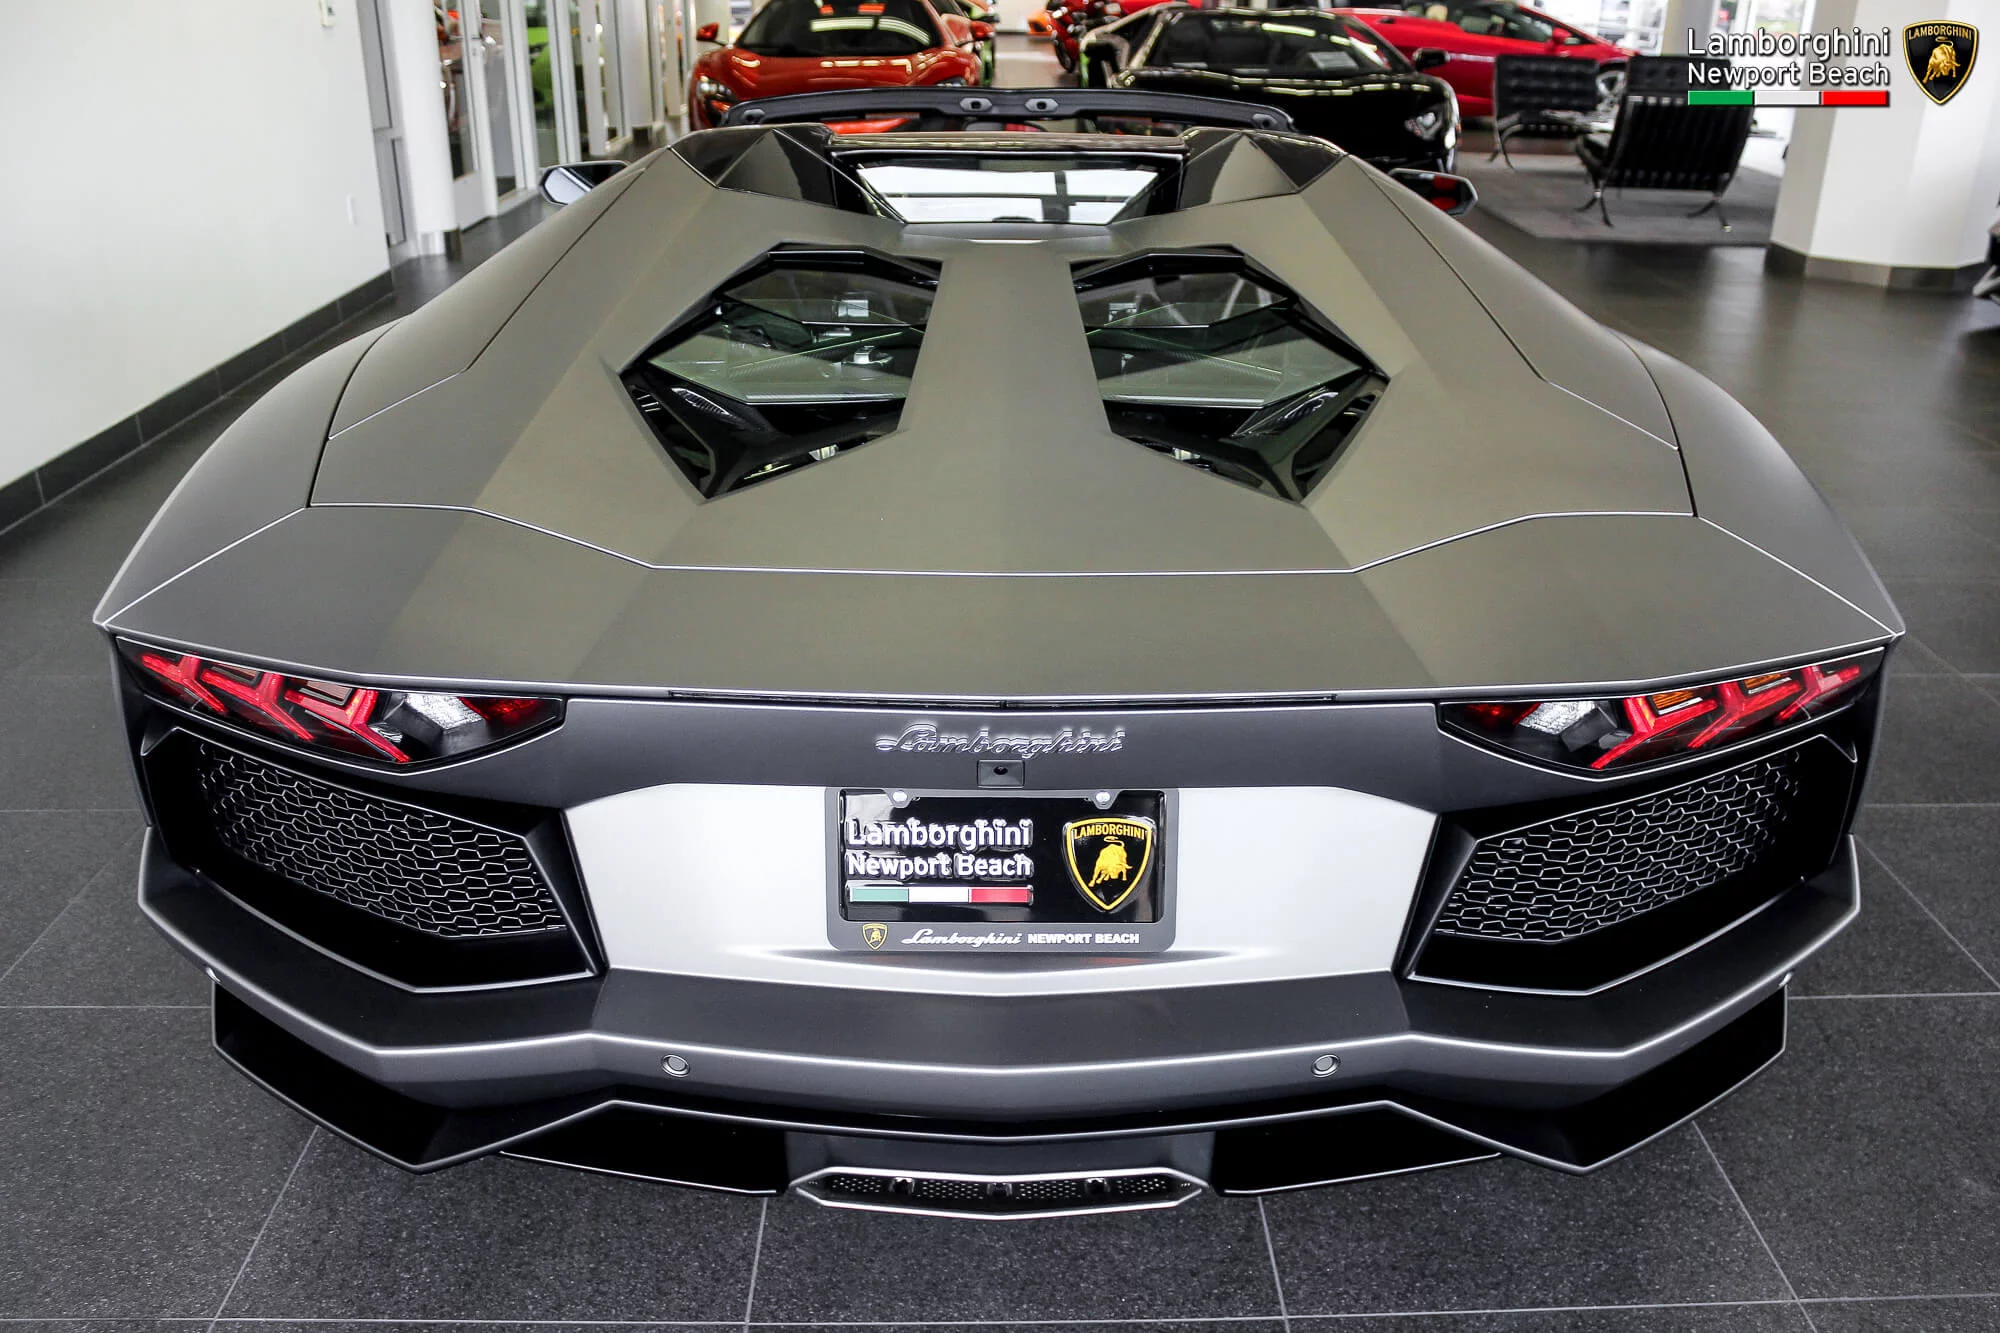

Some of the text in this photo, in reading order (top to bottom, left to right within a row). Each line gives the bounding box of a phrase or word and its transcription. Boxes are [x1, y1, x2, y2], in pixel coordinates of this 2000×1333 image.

[876, 724, 1125, 759] Lamborghini
[848, 820, 1031, 850] Lamborghini
[1073, 823, 1145, 840] LAMBORGHINI
[848, 854, 1031, 879] Newport Beach
[901, 928, 1140, 948] Lamborghini NEWPORT BEACH
